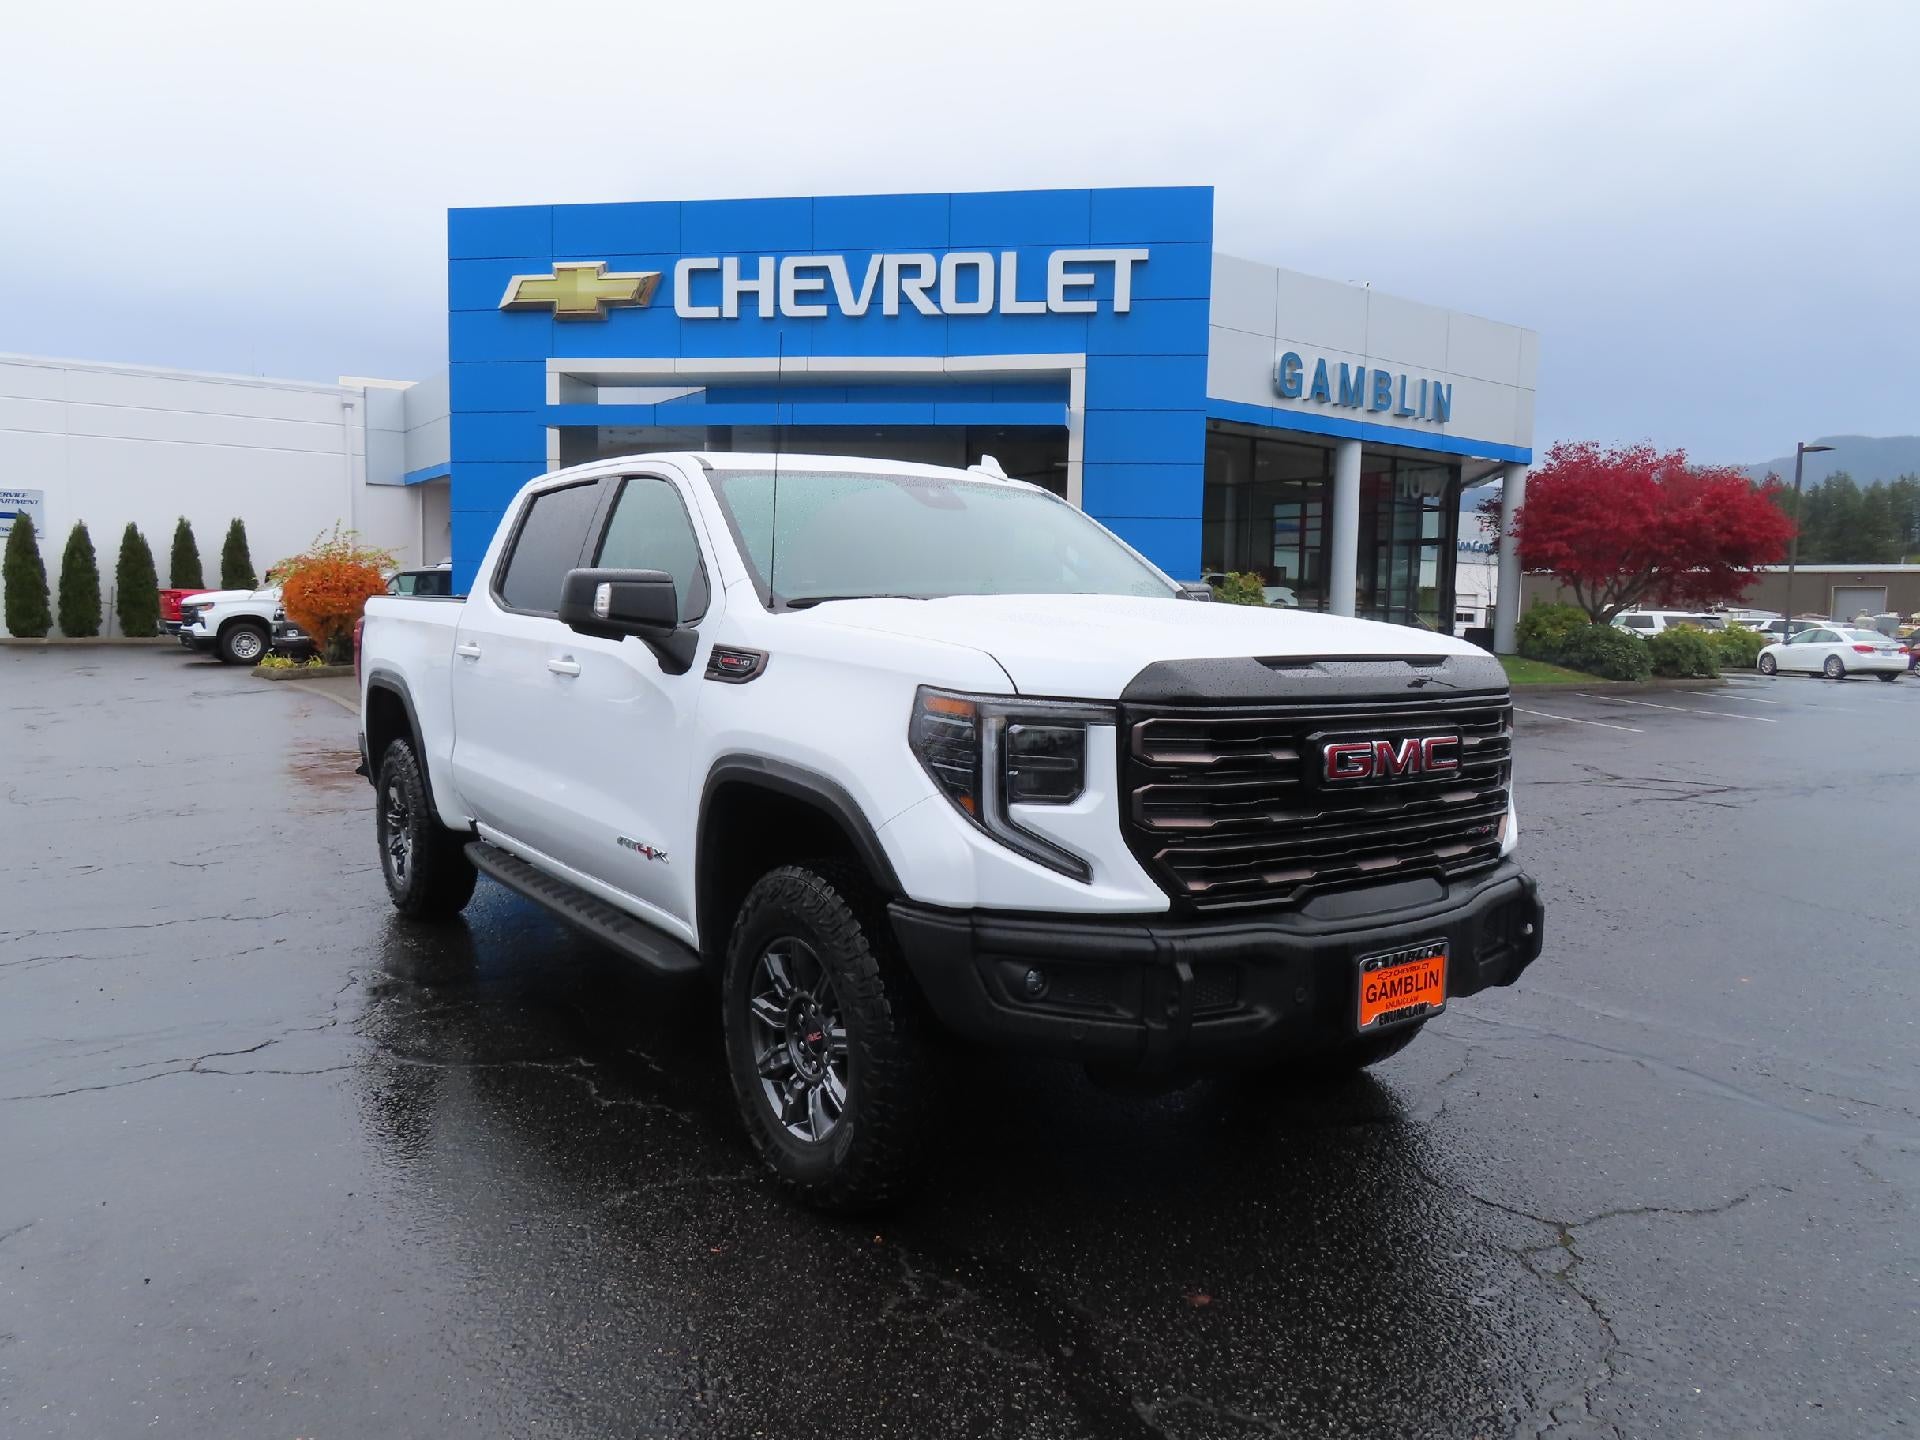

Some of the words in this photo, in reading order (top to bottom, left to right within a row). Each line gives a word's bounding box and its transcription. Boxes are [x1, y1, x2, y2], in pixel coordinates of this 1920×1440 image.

[674, 248, 1149, 319] CHEVROLET
[1276, 352, 1452, 423] GAMBLIN
[1323, 736, 1459, 781] GMC
[1366, 969, 1440, 1004] GAMBLIN
